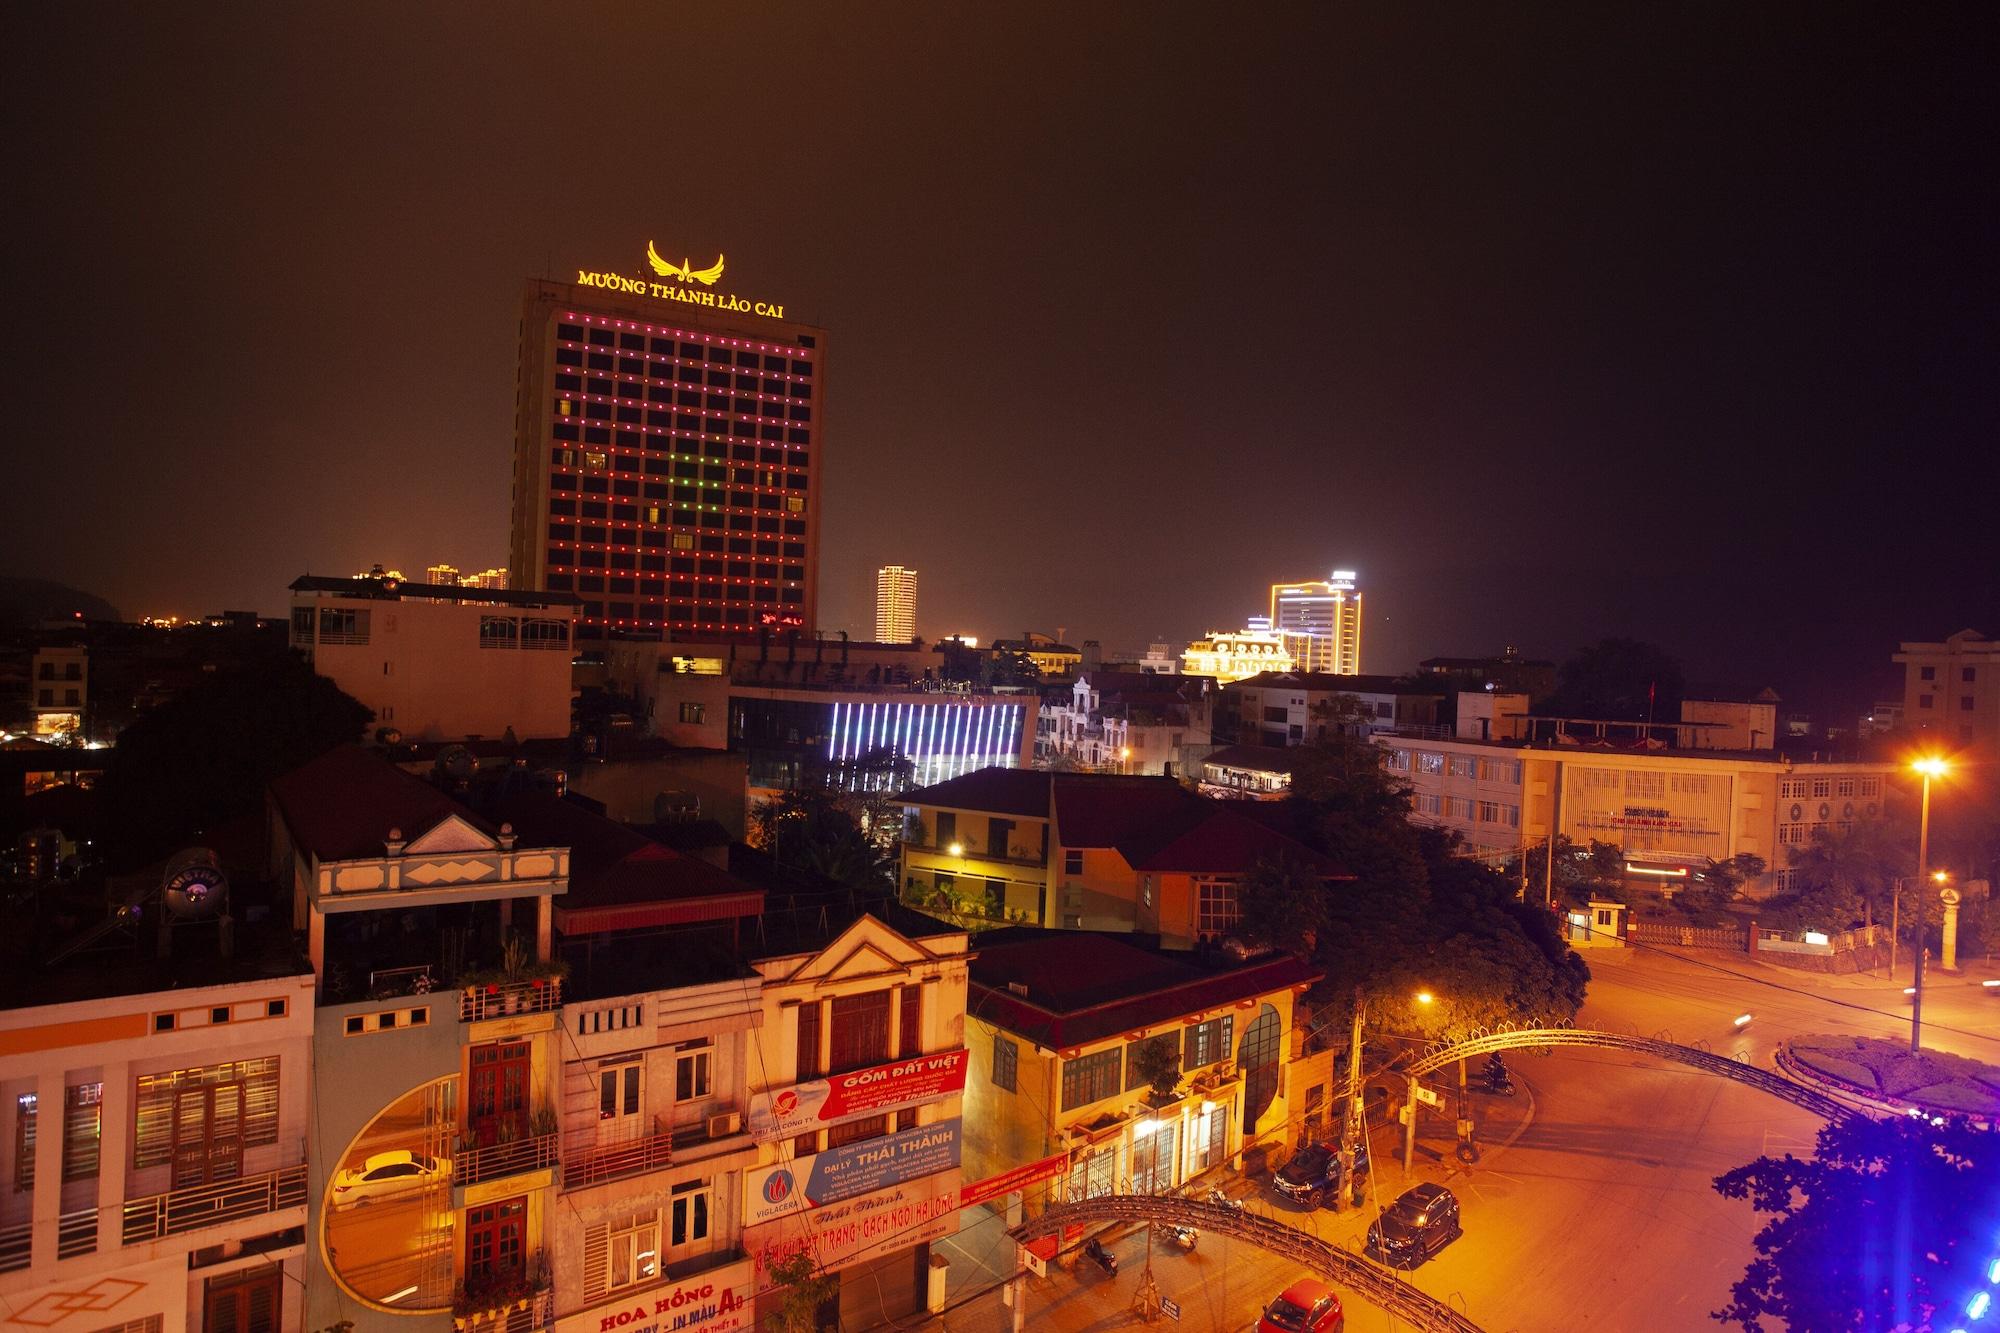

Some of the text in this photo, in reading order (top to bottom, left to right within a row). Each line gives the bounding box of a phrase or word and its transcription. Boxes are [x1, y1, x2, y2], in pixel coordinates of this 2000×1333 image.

[578, 271, 784, 319] MƯỜNG THANH LÀO CAI
[843, 1055, 960, 1088] GỐM ĐẤT VIỆT
[857, 1144, 895, 1166] THÁI
[900, 1130, 953, 1154] THÀNH
[756, 1201, 799, 1219] VIGLACERA
[600, 1284, 714, 1333] HOA HỒNG
[672, 1314, 686, 1331] IN
[689, 1303, 716, 1326] MÀU
